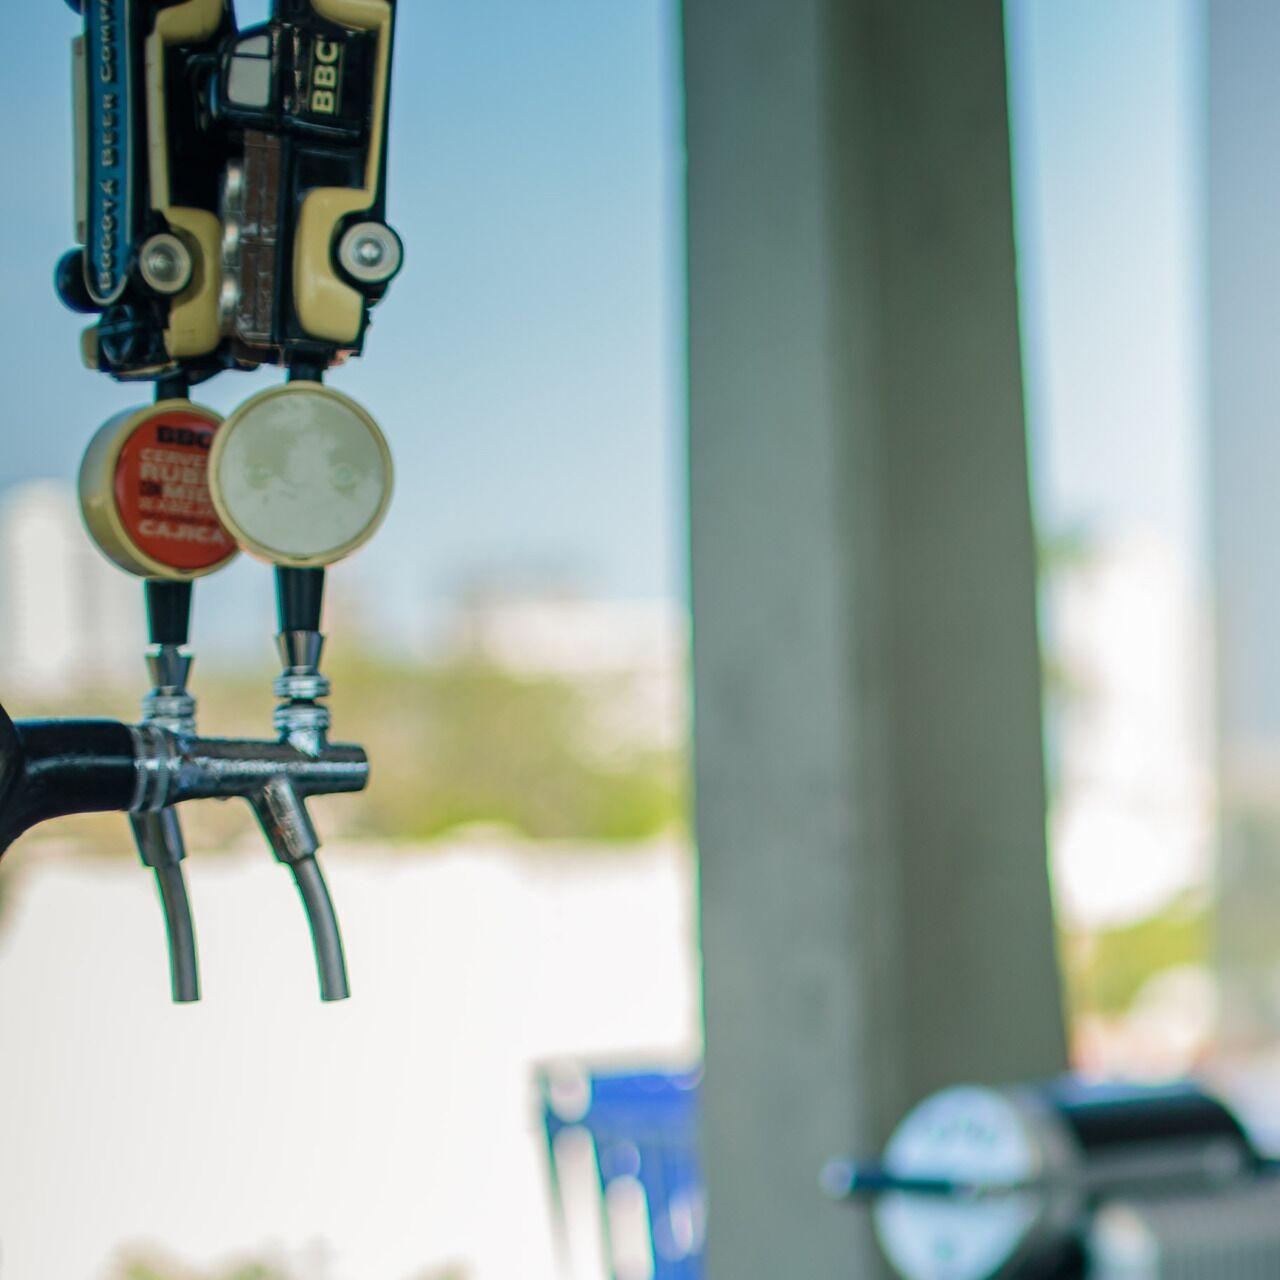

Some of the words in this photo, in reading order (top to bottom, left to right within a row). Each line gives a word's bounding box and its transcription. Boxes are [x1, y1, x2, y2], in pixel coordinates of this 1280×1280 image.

[312, 40, 338, 114] BBC
[102, 93, 113, 167] BEER
[140, 447, 208, 467] CERVE
[156, 425, 213, 449] BBC
